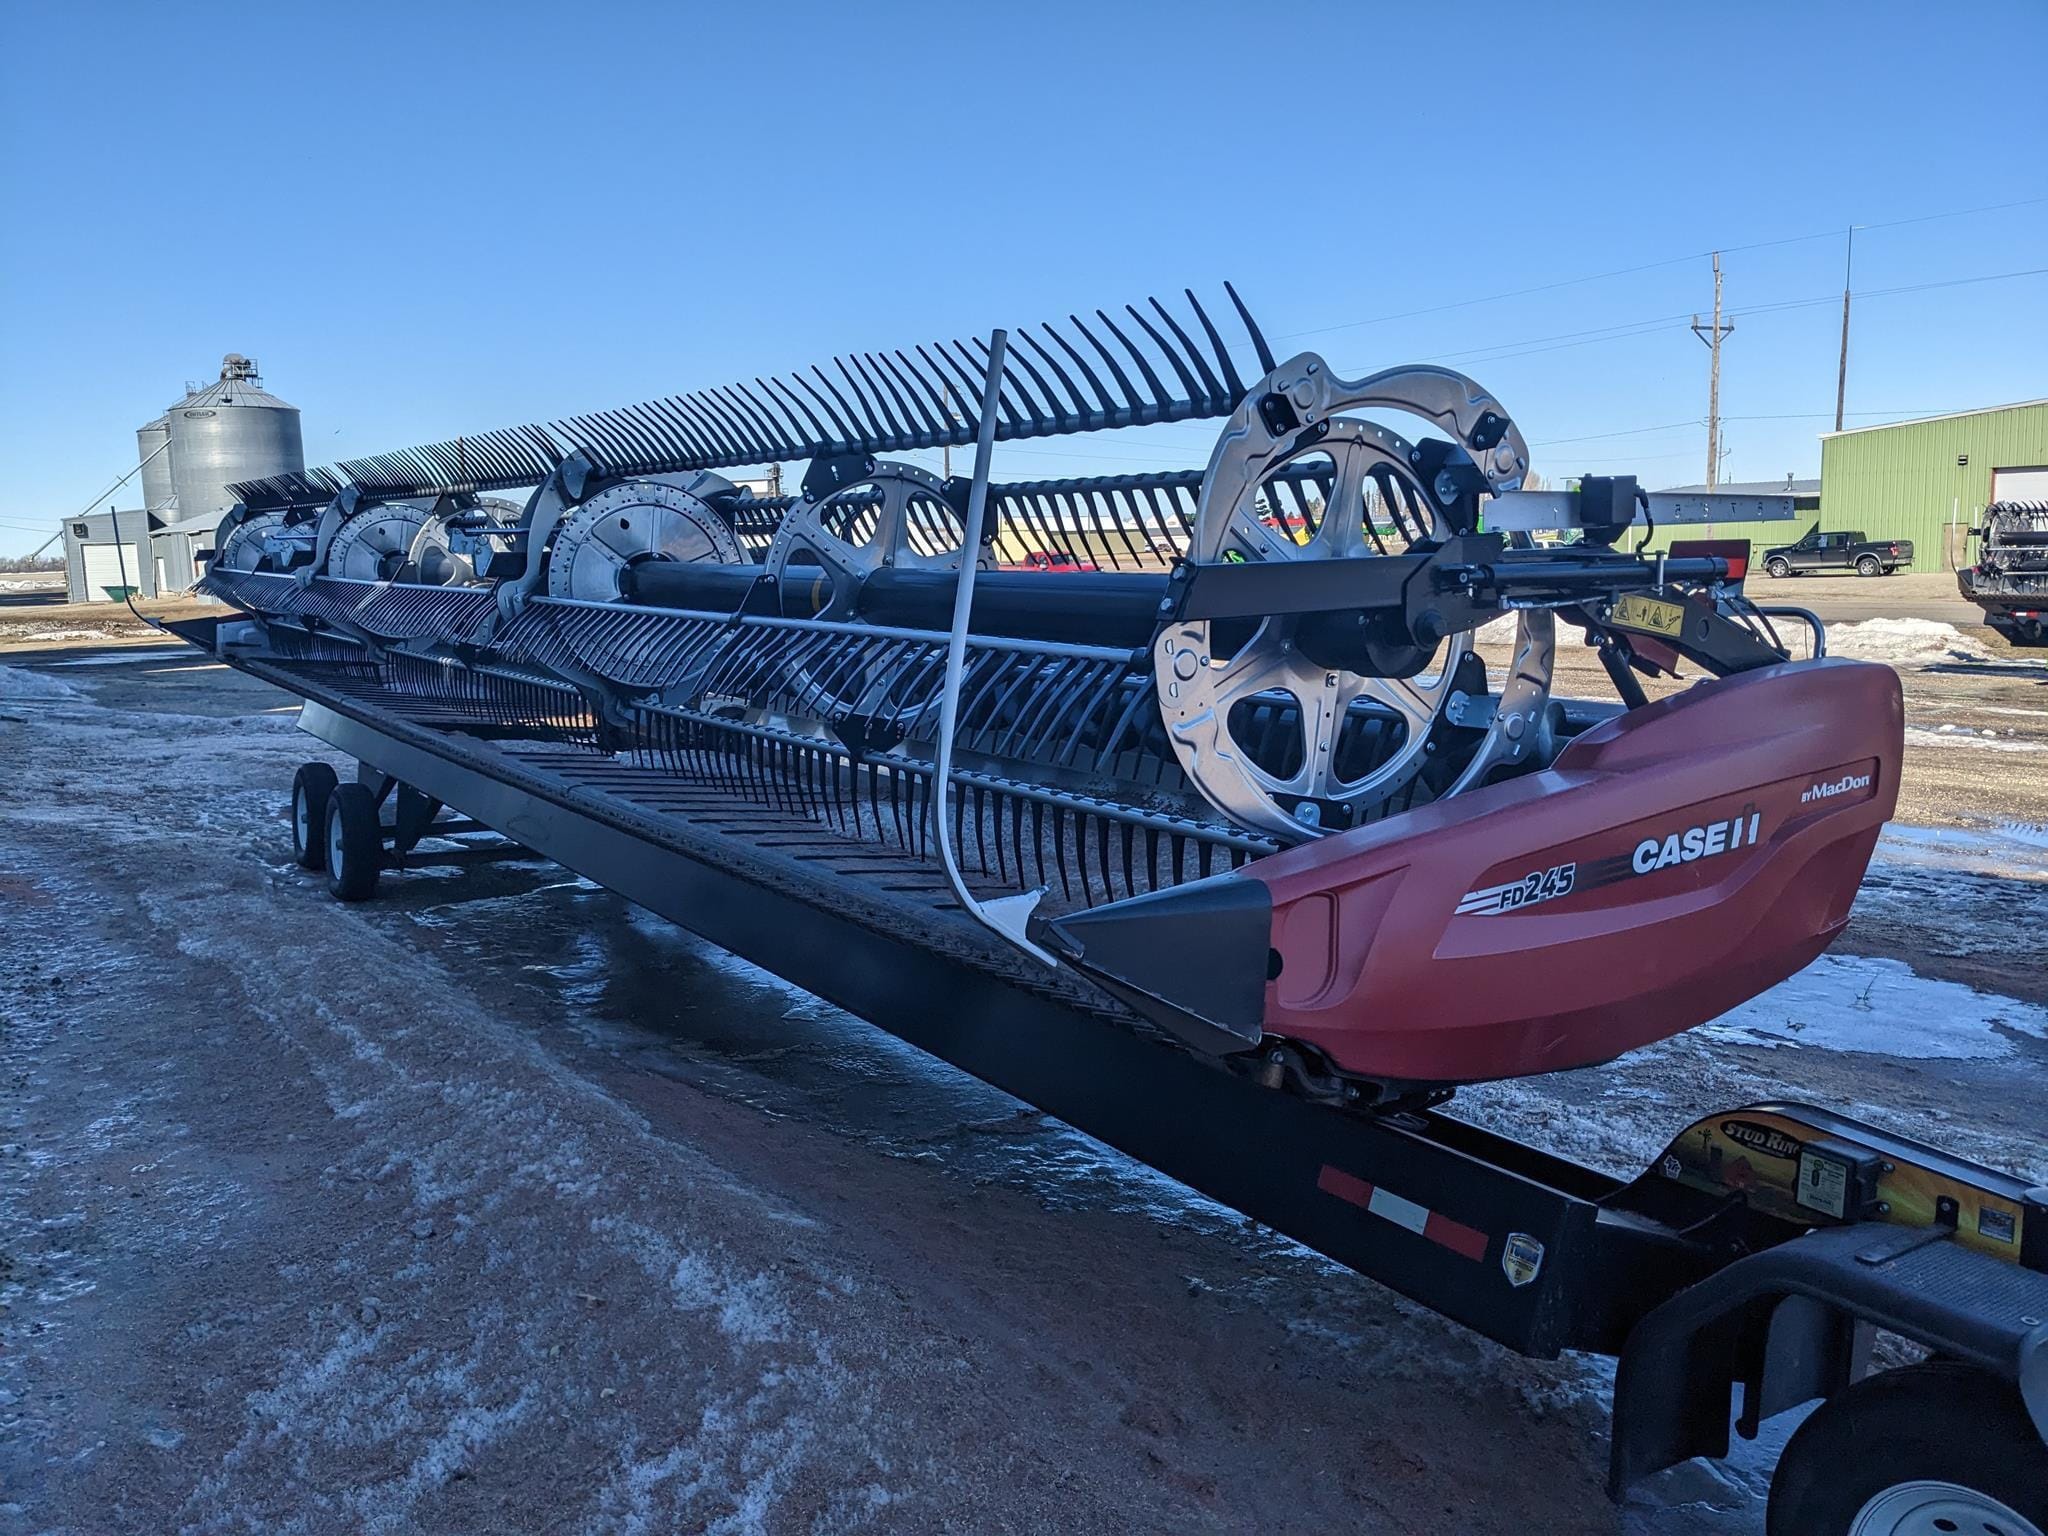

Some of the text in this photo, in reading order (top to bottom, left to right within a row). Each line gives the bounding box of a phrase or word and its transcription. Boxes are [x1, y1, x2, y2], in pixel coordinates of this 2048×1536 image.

[1812, 775, 1870, 800] MacDon
[1499, 862, 1575, 909] FD245
[1725, 1122, 1766, 1144] STUD
